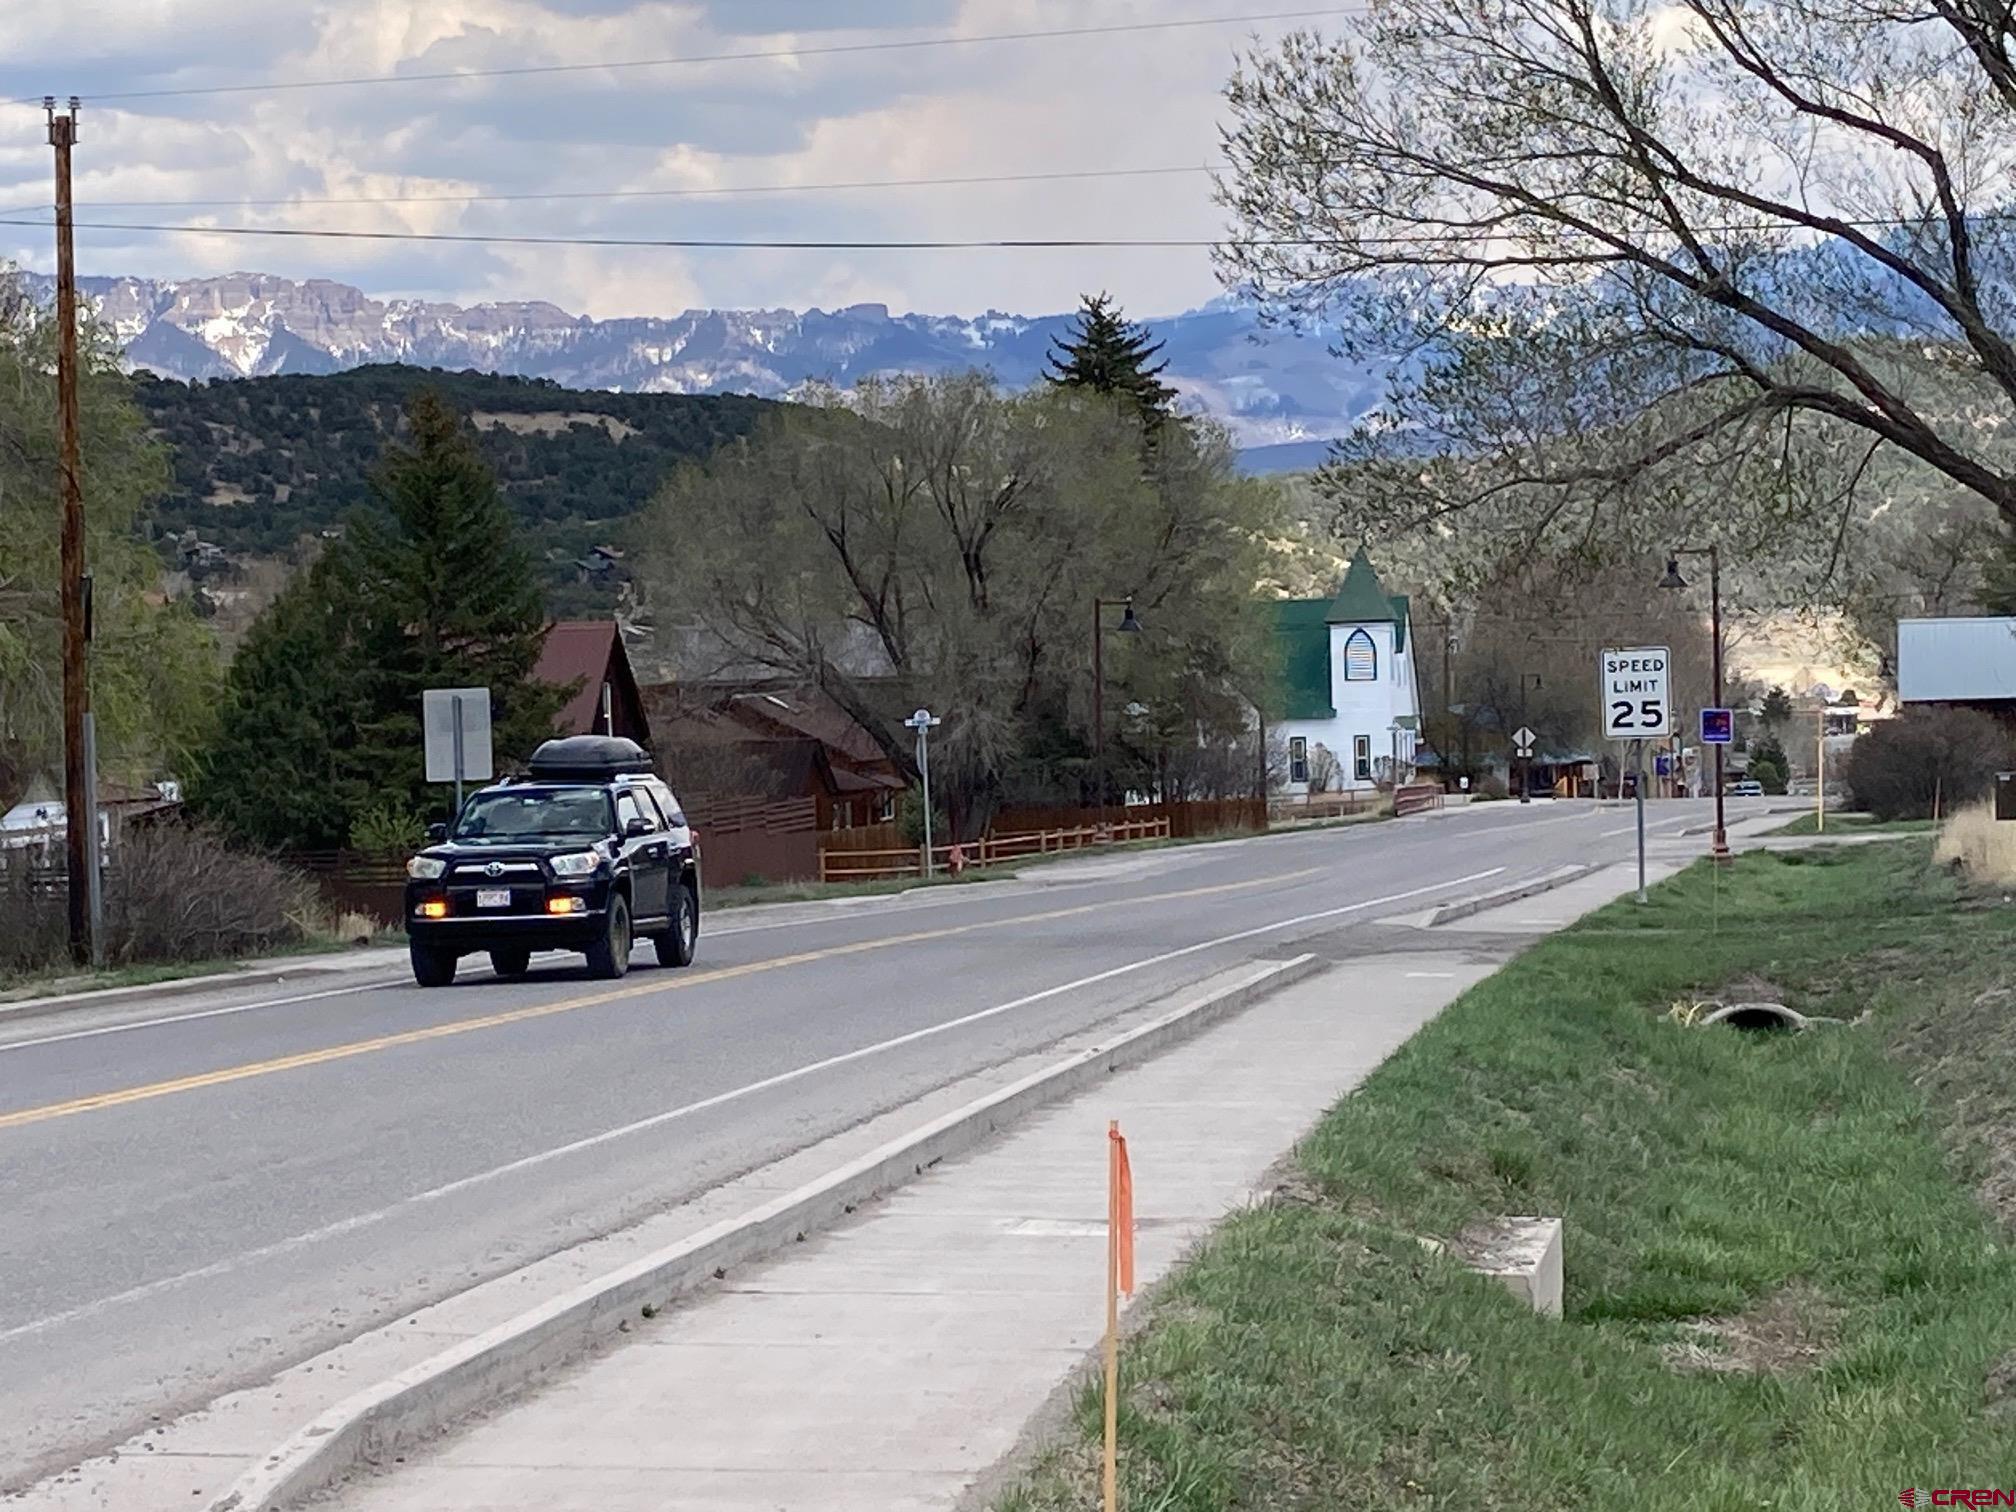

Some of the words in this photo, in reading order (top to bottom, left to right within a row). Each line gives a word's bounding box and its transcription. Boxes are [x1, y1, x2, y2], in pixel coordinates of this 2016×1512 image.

[1607, 660, 1664, 673] SPEED
[1613, 679, 1658, 694] LIMIT
[1611, 700, 1663, 728] 25
